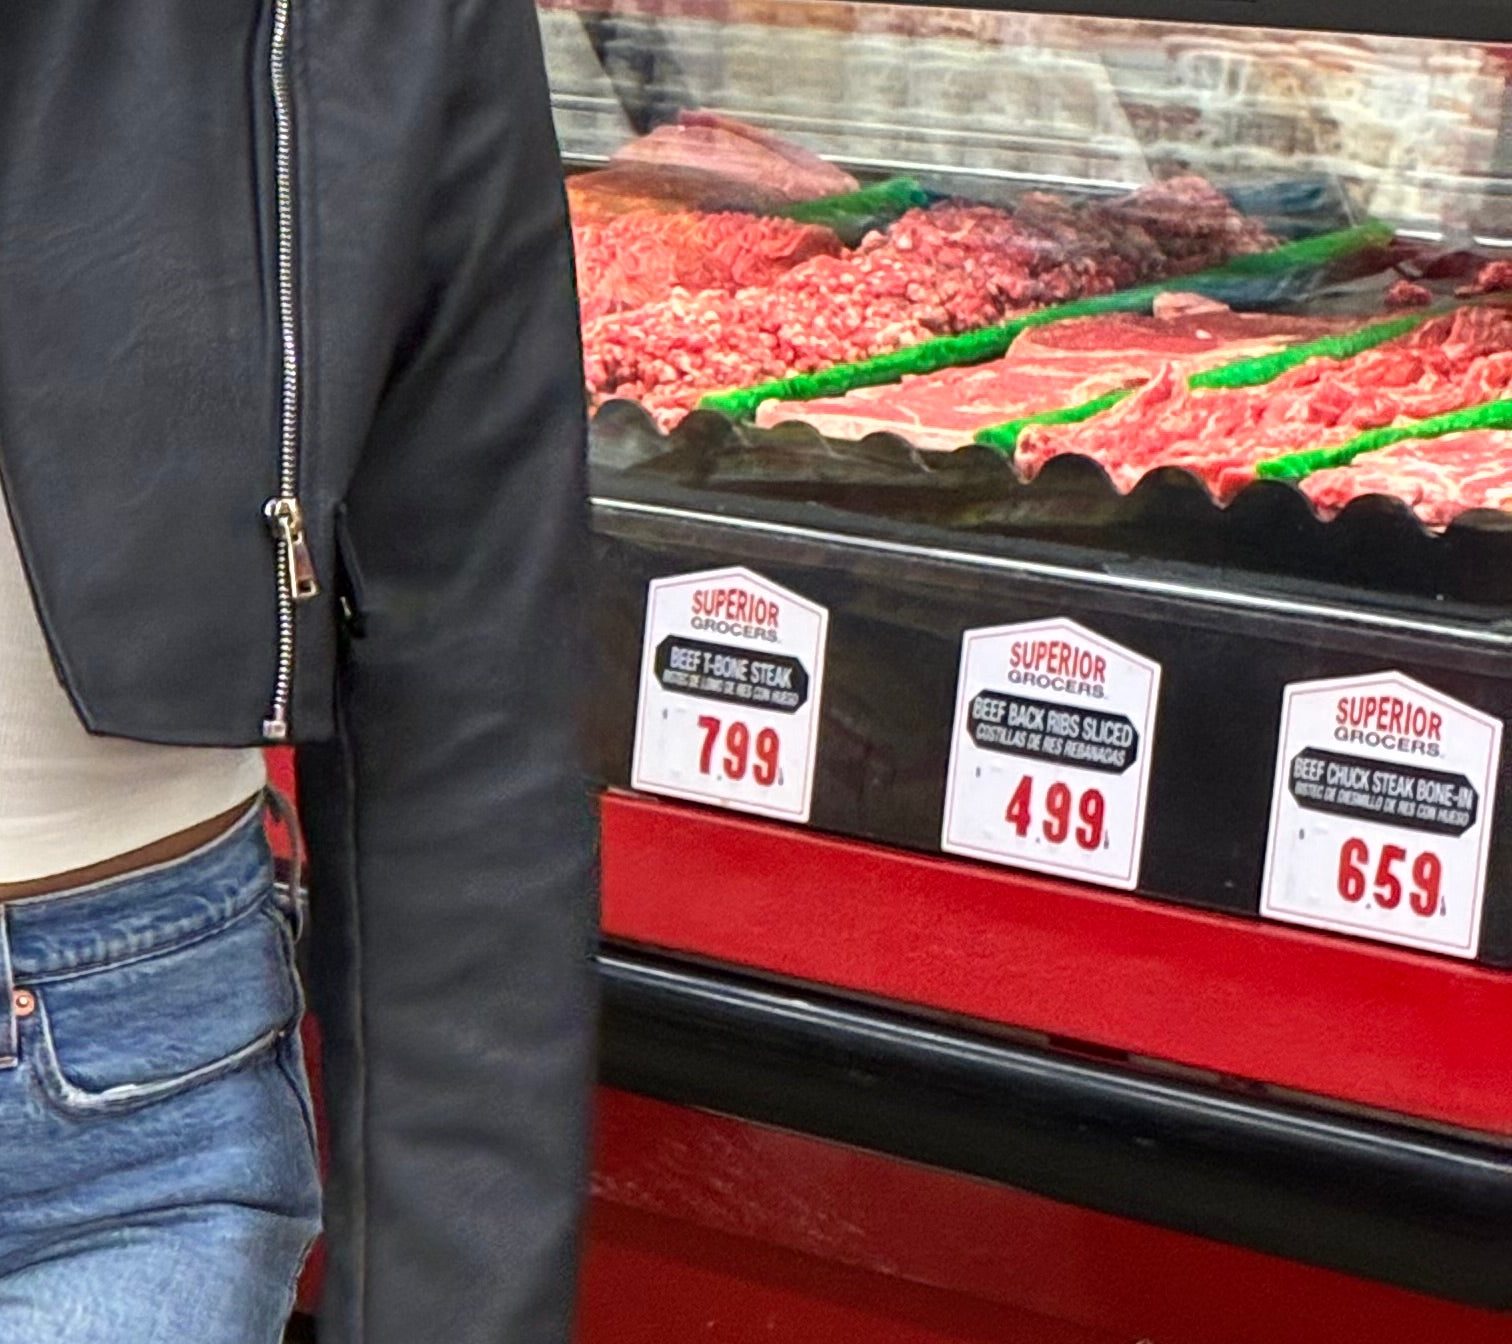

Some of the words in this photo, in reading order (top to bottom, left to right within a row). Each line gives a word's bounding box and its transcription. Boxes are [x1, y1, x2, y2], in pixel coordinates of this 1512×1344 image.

[692, 588, 780, 629] SUPERIOR
[670, 646, 701, 671] BEEF
[750, 661, 793, 689] STEAK
[1010, 641, 1106, 683] SUPERIOR
[972, 697, 1006, 723] BEEF
[1008, 702, 1045, 731] BACK
[1046, 710, 1080, 738] RIBS
[1082, 717, 1133, 748] SLICED
[1335, 696, 1443, 741] SUPERIOR
[1293, 757, 1326, 781] BEEF
[1326, 763, 1370, 791] CHUCK
[1372, 771, 1416, 799] STEAK
[1416, 779, 1473, 810] BONE-IN
